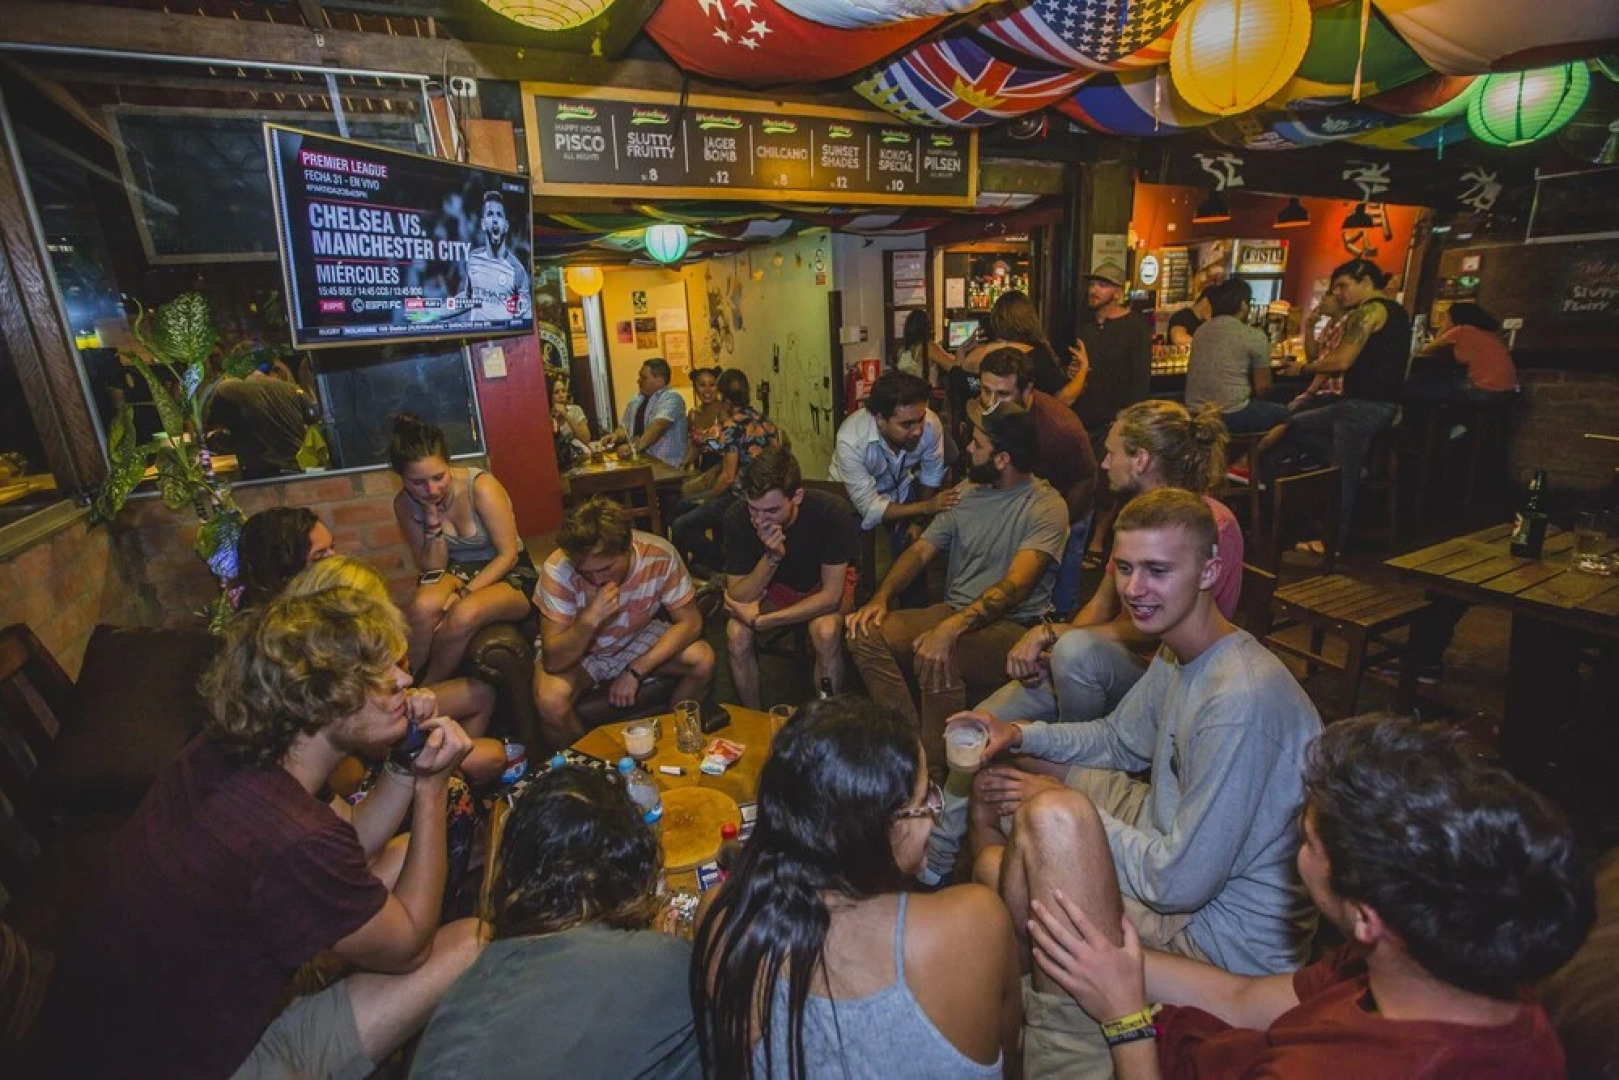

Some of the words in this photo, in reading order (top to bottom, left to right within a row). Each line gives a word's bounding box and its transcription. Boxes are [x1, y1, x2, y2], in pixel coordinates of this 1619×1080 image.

[555, 133, 605, 152] PISCO
[627, 132, 673, 147] SLUTTY
[626, 146, 675, 160] FRUITTY
[704, 149, 737, 163] BOMB
[756, 145, 809, 161] CHILCANO
[821, 144, 860, 158] SUNSET
[302, 151, 349, 171] PREMIER
[351, 160, 387, 178] LEAGUE
[821, 155, 860, 170] SHADES
[878, 160, 914, 173] SPECIAL
[924, 156, 961, 173] PILSEN
[304, 169, 332, 183] FECHA
[333, 174, 343, 185] 31
[349, 176, 361, 188] EN
[361, 178, 380, 191] VIVO
[649, 168, 658, 182] 8
[716, 171, 730, 184] 12
[837, 176, 848, 189] 12
[891, 180, 904, 192] 10
[308, 203, 395, 234] CHELSEA
[398, 213, 427, 237] VS.
[311, 230, 434, 260] MANCHESTER
[438, 240, 472, 261] CITY
[316, 261, 400, 285] MIÉRCOLES
